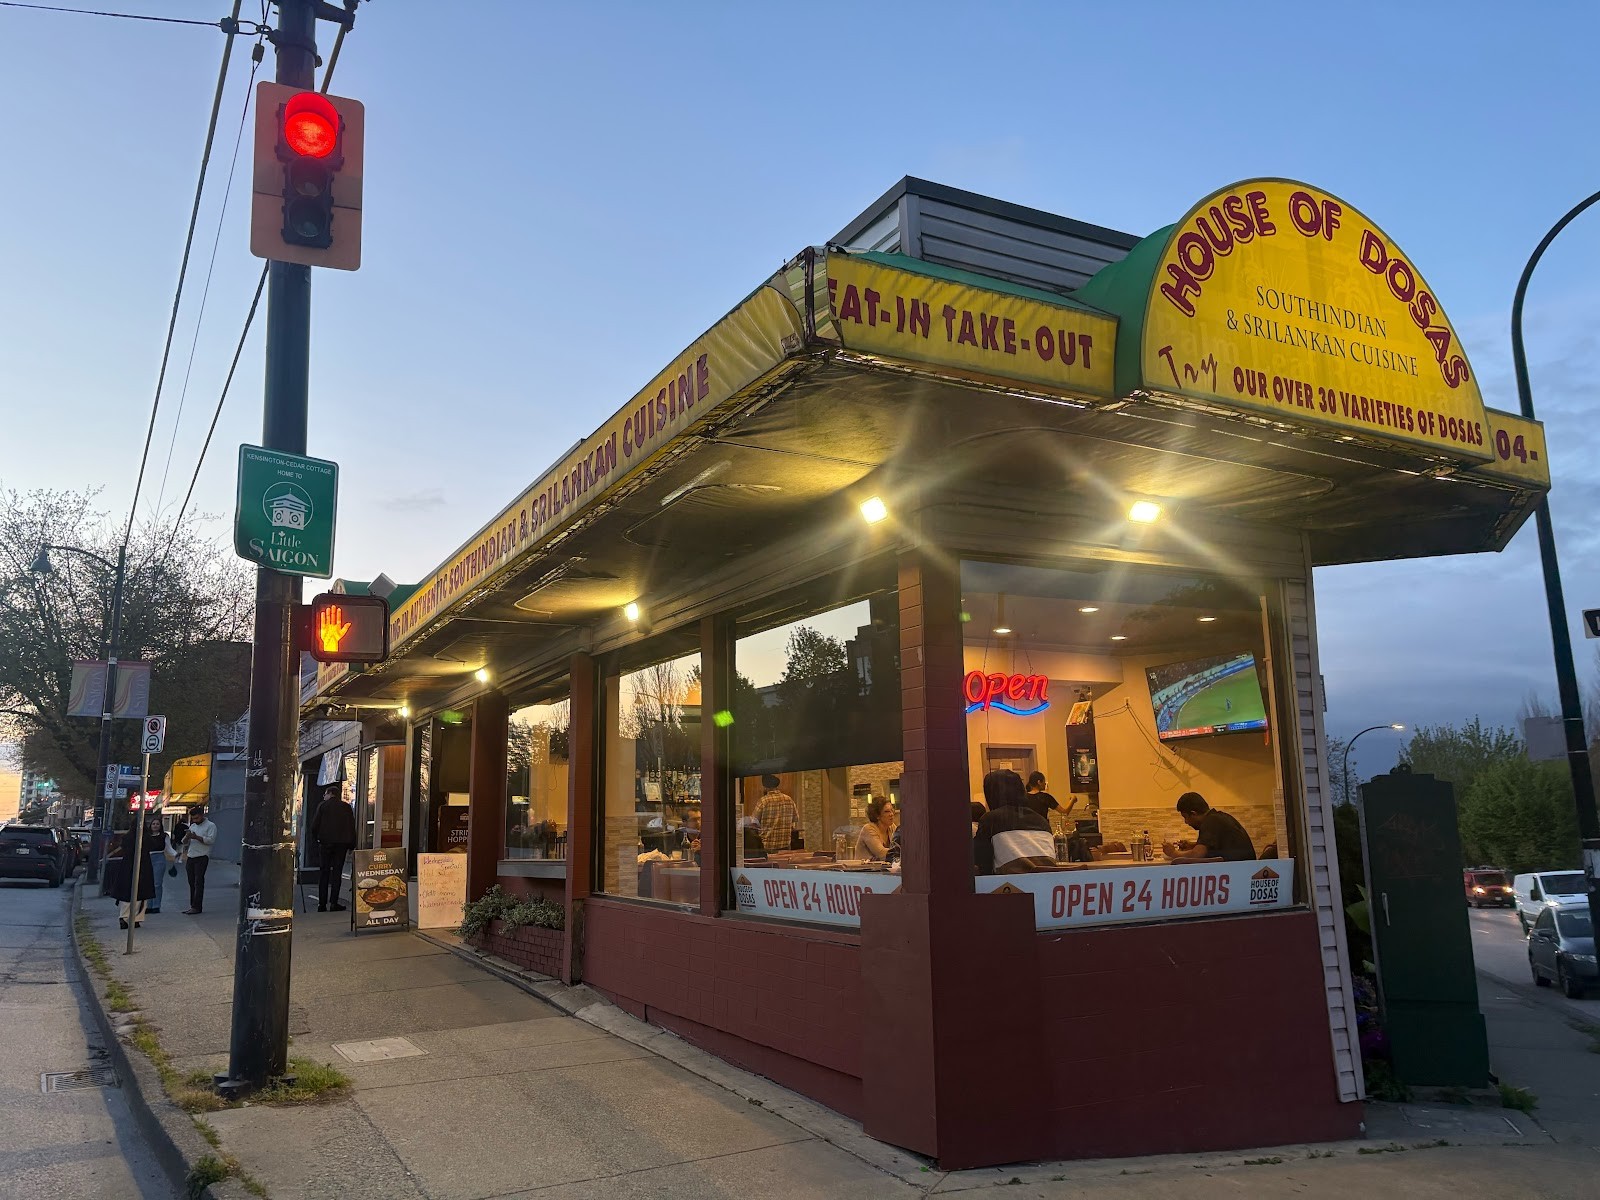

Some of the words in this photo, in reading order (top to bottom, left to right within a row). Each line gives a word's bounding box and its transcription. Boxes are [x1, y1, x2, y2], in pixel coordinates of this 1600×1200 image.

[1161, 190, 1276, 318] HOUSE
[1289, 191, 1342, 241] OF
[1359, 229, 1469, 389] DOSAS
[828, 278, 931, 339] EAT-IN
[942, 304, 1093, 369] TAKE-OUT
[1256, 285, 1387, 340] SOUTHINDIAN
[1227, 309, 1239, 332] &
[1243, 312, 1346, 359] SRILANKAN
[1350, 341, 1419, 378] CUISINE
[1158, 345, 1218, 393] Try
[1233, 366, 1269, 400] OUR
[1272, 376, 1315, 410] OVER
[1318, 387, 1336, 414] 30
[1339, 391, 1415, 432] VARIETIES
[1418, 410, 1435, 435] OF
[1438, 414, 1483, 446] DOSAS
[1495, 429, 1538, 463] 04-
[246, 453, 306, 470] KENSINGTON-CEDAR
[306, 464, 332, 475] COTTAGE
[277, 469, 294, 478] HOME
[295, 472, 303, 480] TO
[401, 609, 409, 635] IN
[409, 573, 448, 629] AUTHENTIC
[449, 518, 517, 595] SOUTHINDIAN
[520, 509, 528, 542] &
[531, 431, 617, 535] SRILANKAN
[623, 353, 710, 458] CUISINE
[249, 537, 319, 567] SAIGON
[271, 531, 302, 548] Little
[963, 670, 1049, 711] Open
[450, 829, 469, 837] STRIN
[357, 868, 405, 878] WEDNESDAY
[1250, 880, 1271, 888] HOUSE
[1271, 879, 1279, 887] OF
[763, 880, 799, 910] OPEN
[801, 881, 822, 912] 24
[824, 883, 873, 917] HOUR
[1051, 881, 1114, 919] OPEN
[1122, 879, 1153, 912] 24
[1161, 874, 1230, 910] HOURS
[1250, 887, 1279, 900] DOSAS
